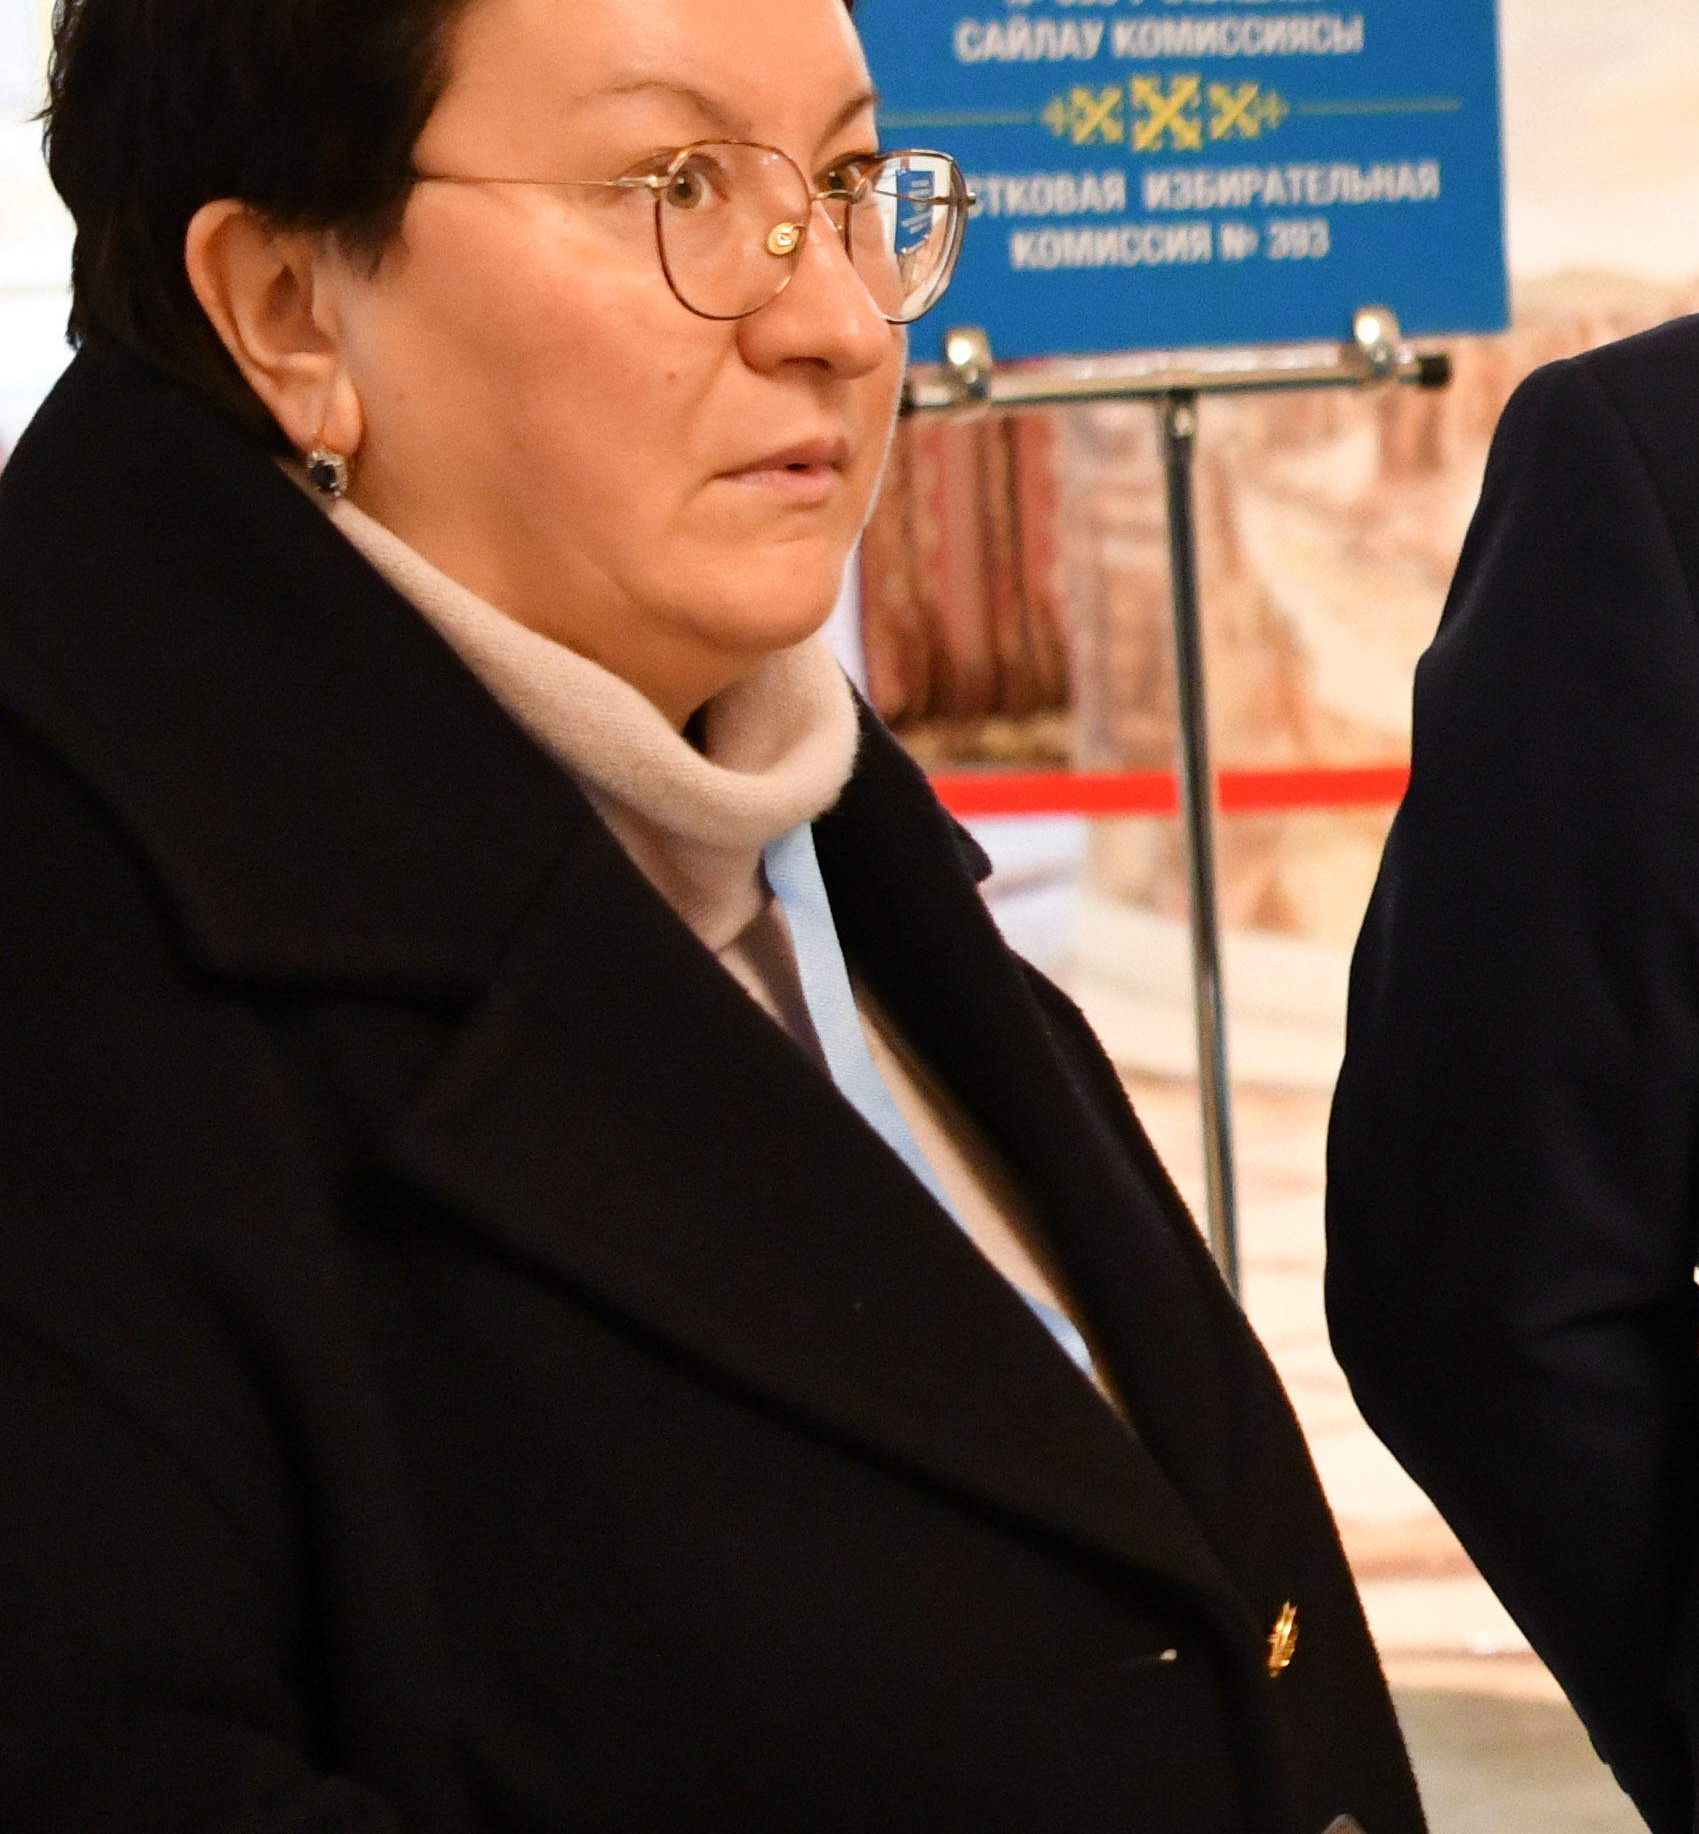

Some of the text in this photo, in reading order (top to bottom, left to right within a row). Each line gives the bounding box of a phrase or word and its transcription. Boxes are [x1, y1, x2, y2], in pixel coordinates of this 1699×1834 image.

[954, 13, 1364, 63] САЙЛАУ КОМИССИЯСЫ
[1142, 160, 1440, 212] ИЗБИРАТЕЛЬНАЯ
[1010, 221, 1211, 270] КОМИССИЯ
